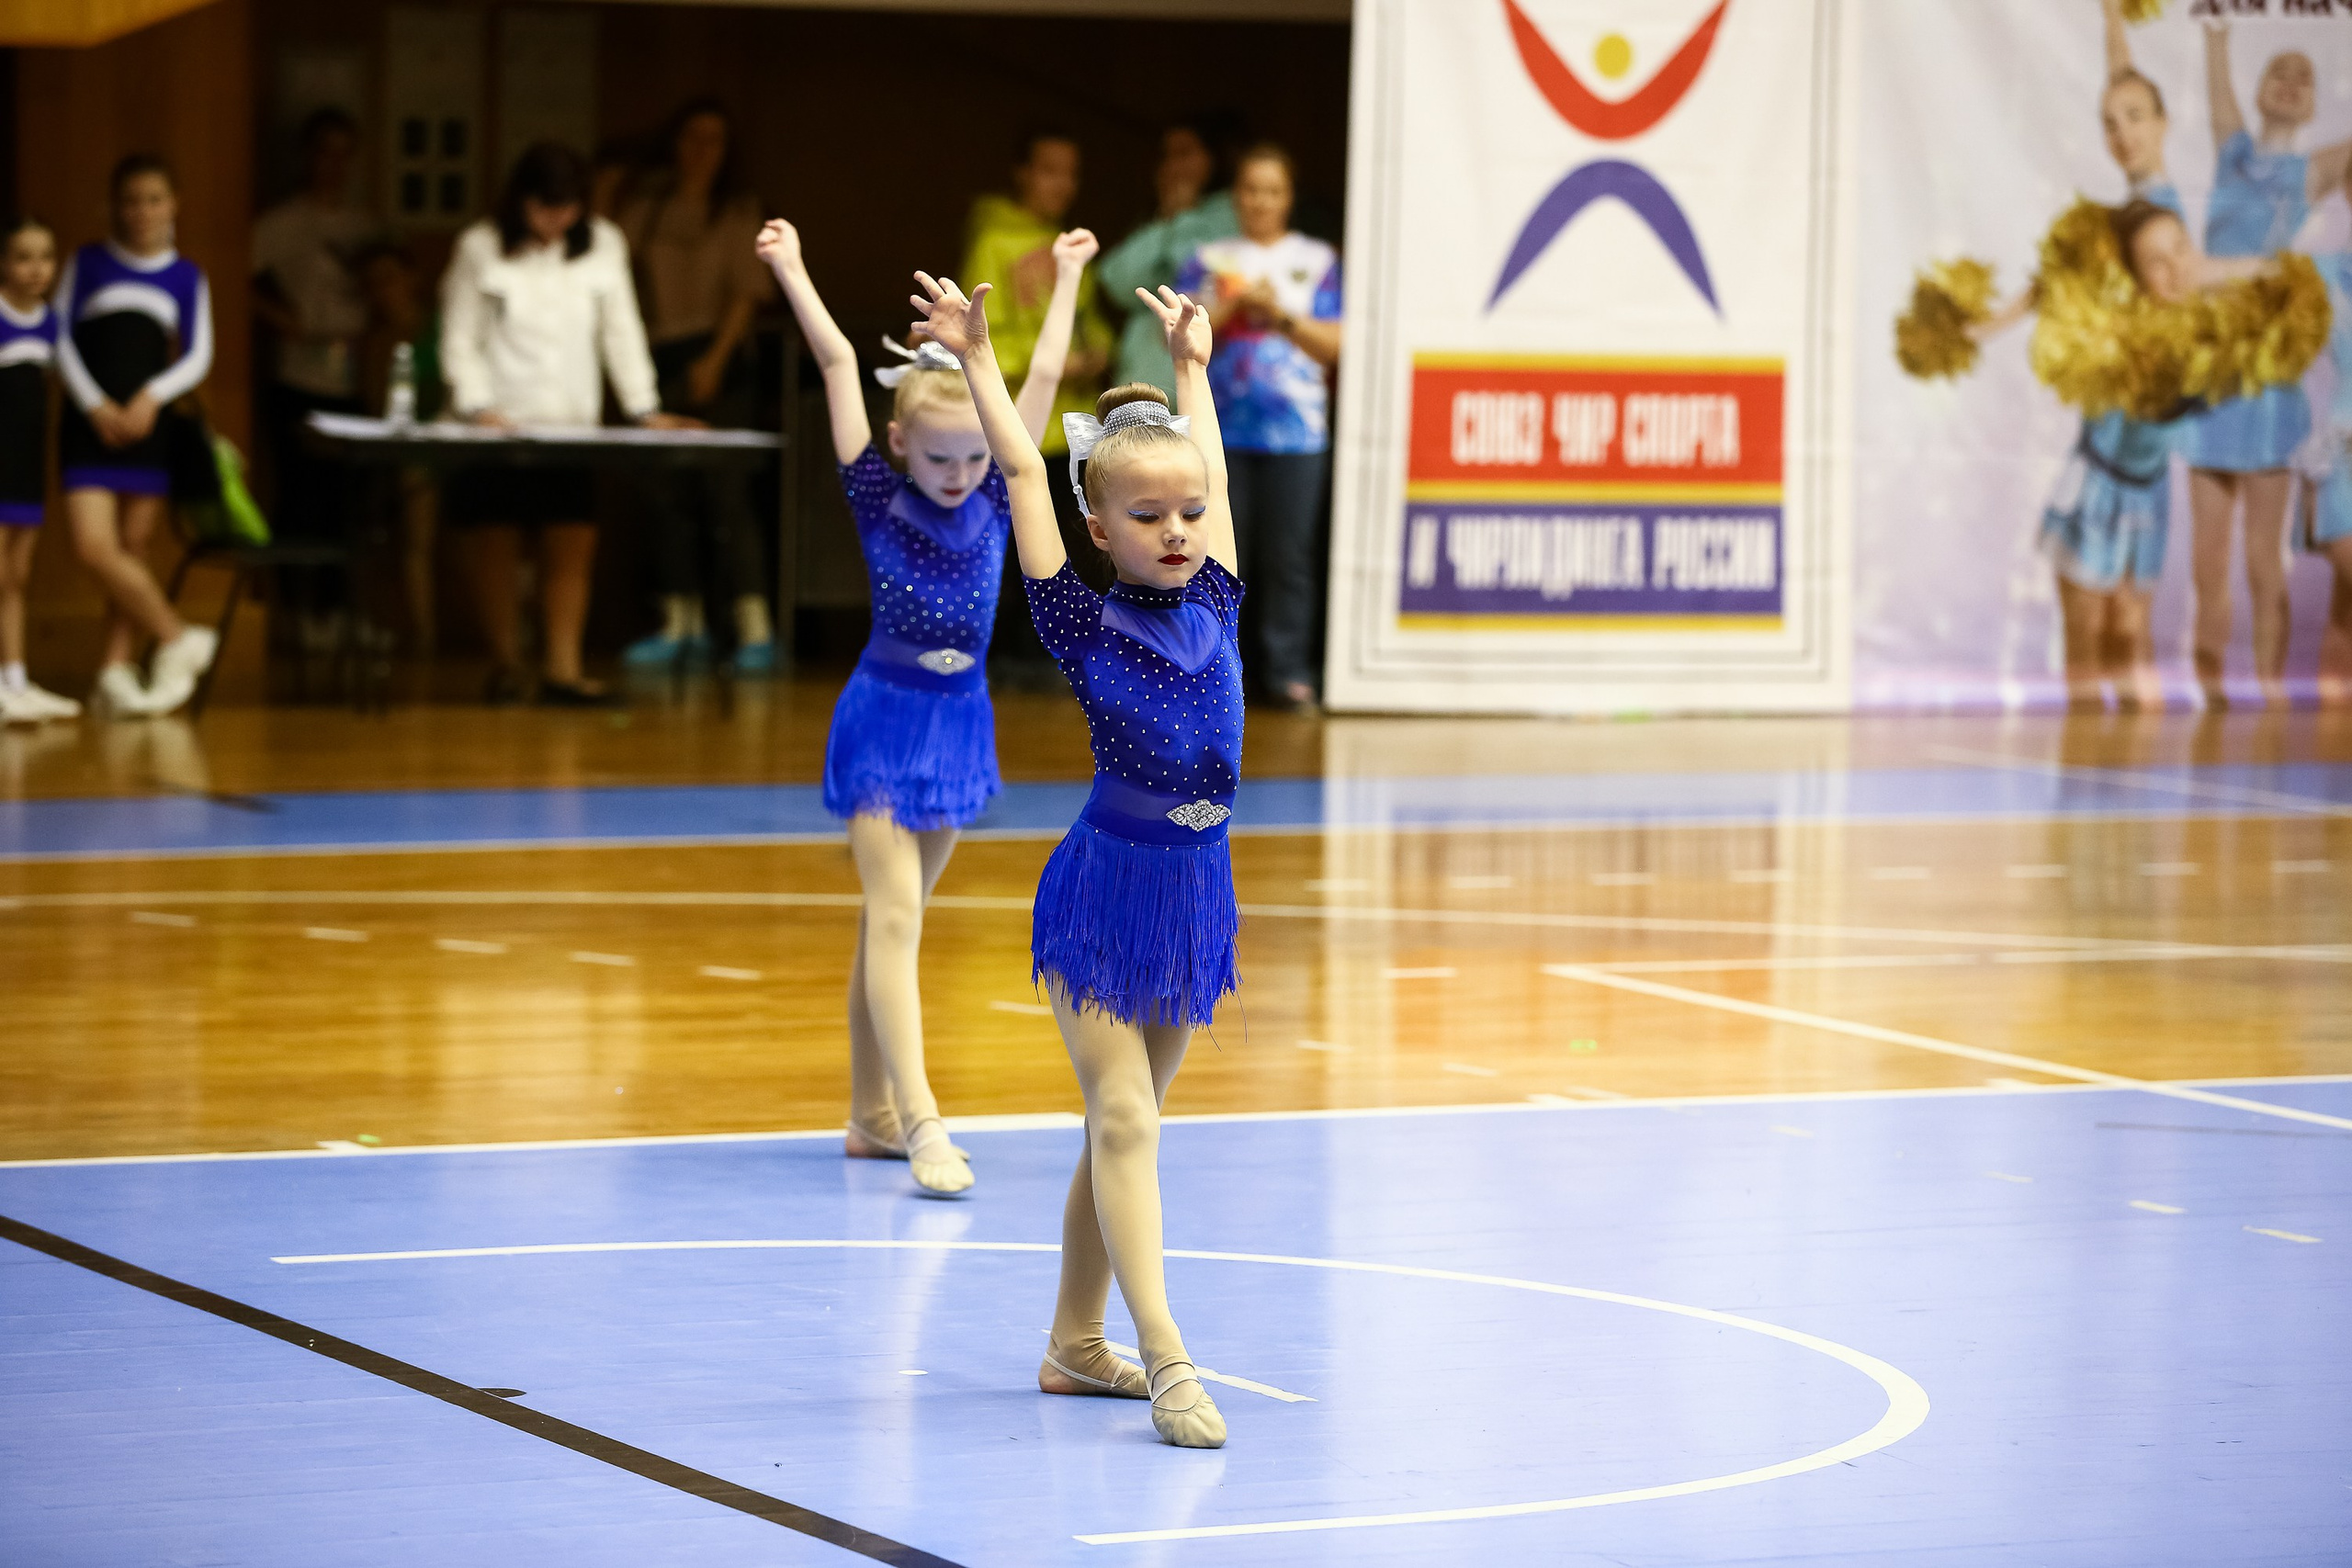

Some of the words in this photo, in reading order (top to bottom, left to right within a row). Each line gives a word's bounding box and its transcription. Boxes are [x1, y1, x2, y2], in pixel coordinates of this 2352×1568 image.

[1553, 391, 1618, 467] ЧИР
[1623, 392, 1740, 468] СПОРТА
[1408, 515, 1439, 591] И
[1653, 517, 1777, 592] РОССИИ
